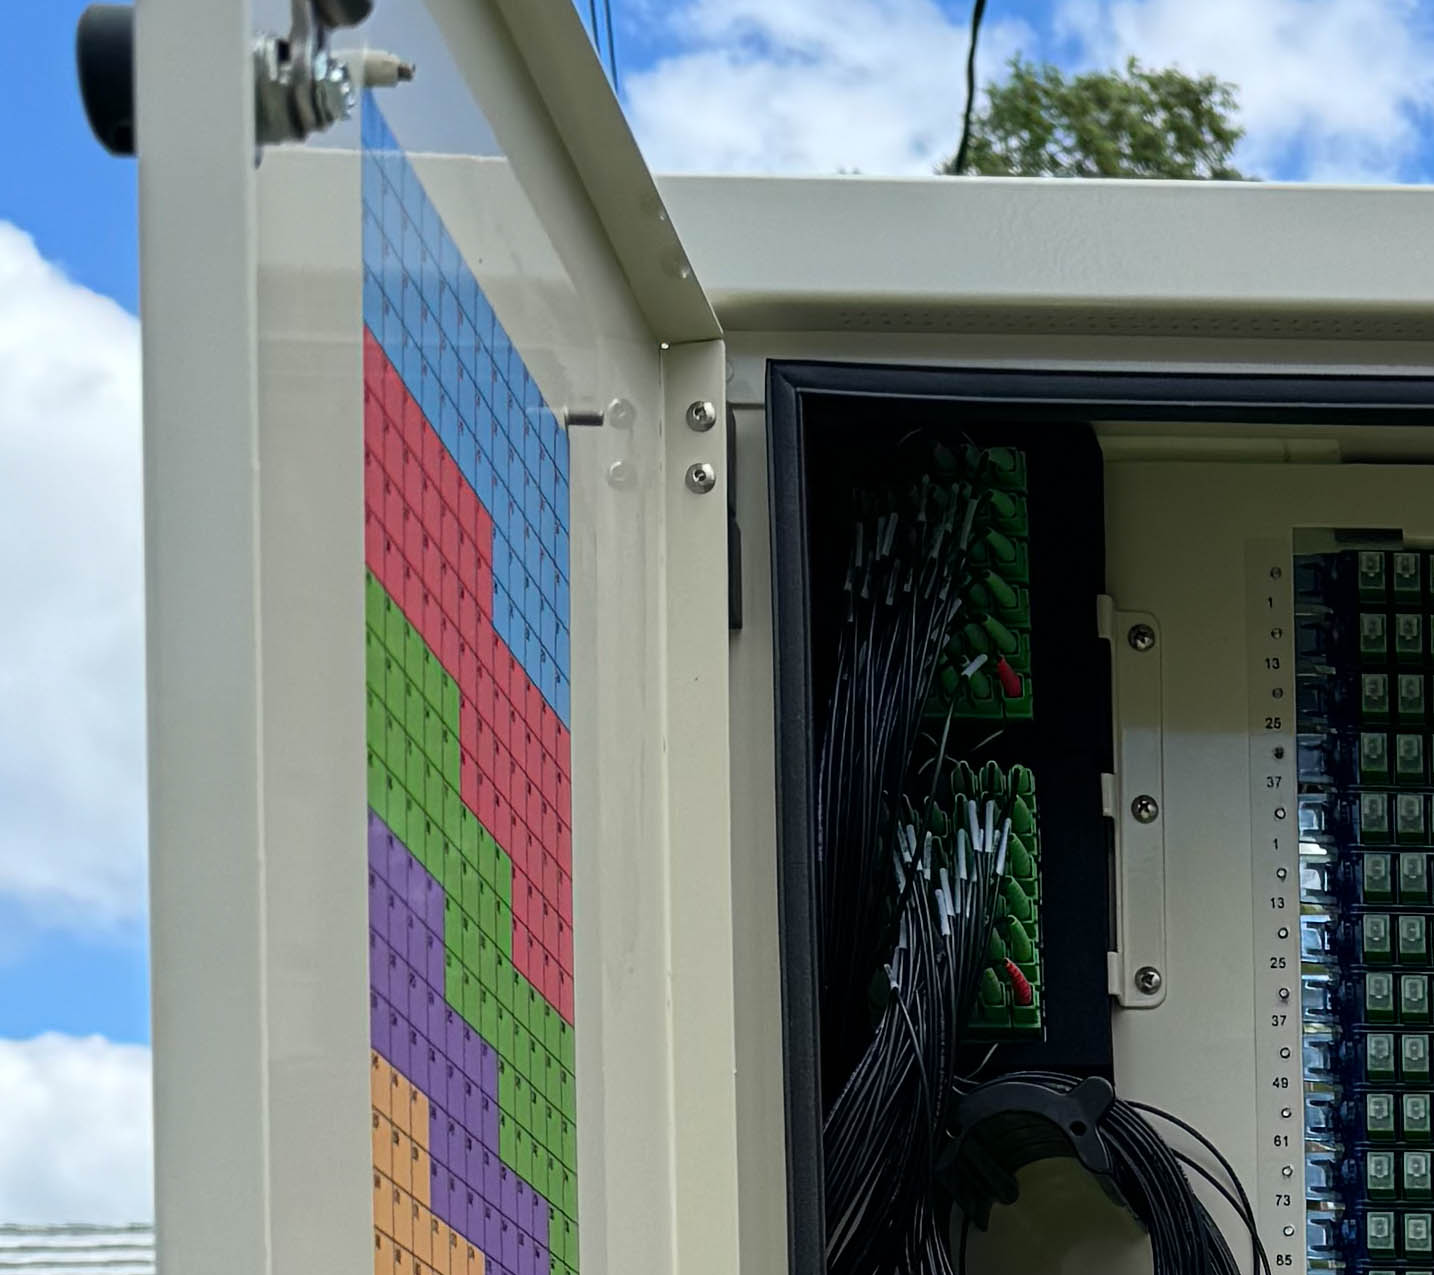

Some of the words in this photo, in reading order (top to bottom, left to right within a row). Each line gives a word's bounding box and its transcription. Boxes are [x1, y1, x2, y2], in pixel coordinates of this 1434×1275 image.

[1267, 596, 1273, 609] 1
[1265, 657, 1281, 670] 13
[1265, 716, 1282, 730] 25
[1266, 775, 1282, 789] 37
[1273, 838, 1279, 851] 1
[1270, 896, 1285, 909] 13
[1270, 956, 1287, 969] 25
[1271, 1014, 1287, 1027] 37
[1272, 1076, 1289, 1089] 49
[1273, 1134, 1289, 1147] 61
[1275, 1194, 1291, 1207] 73
[1276, 1254, 1293, 1266] 85
